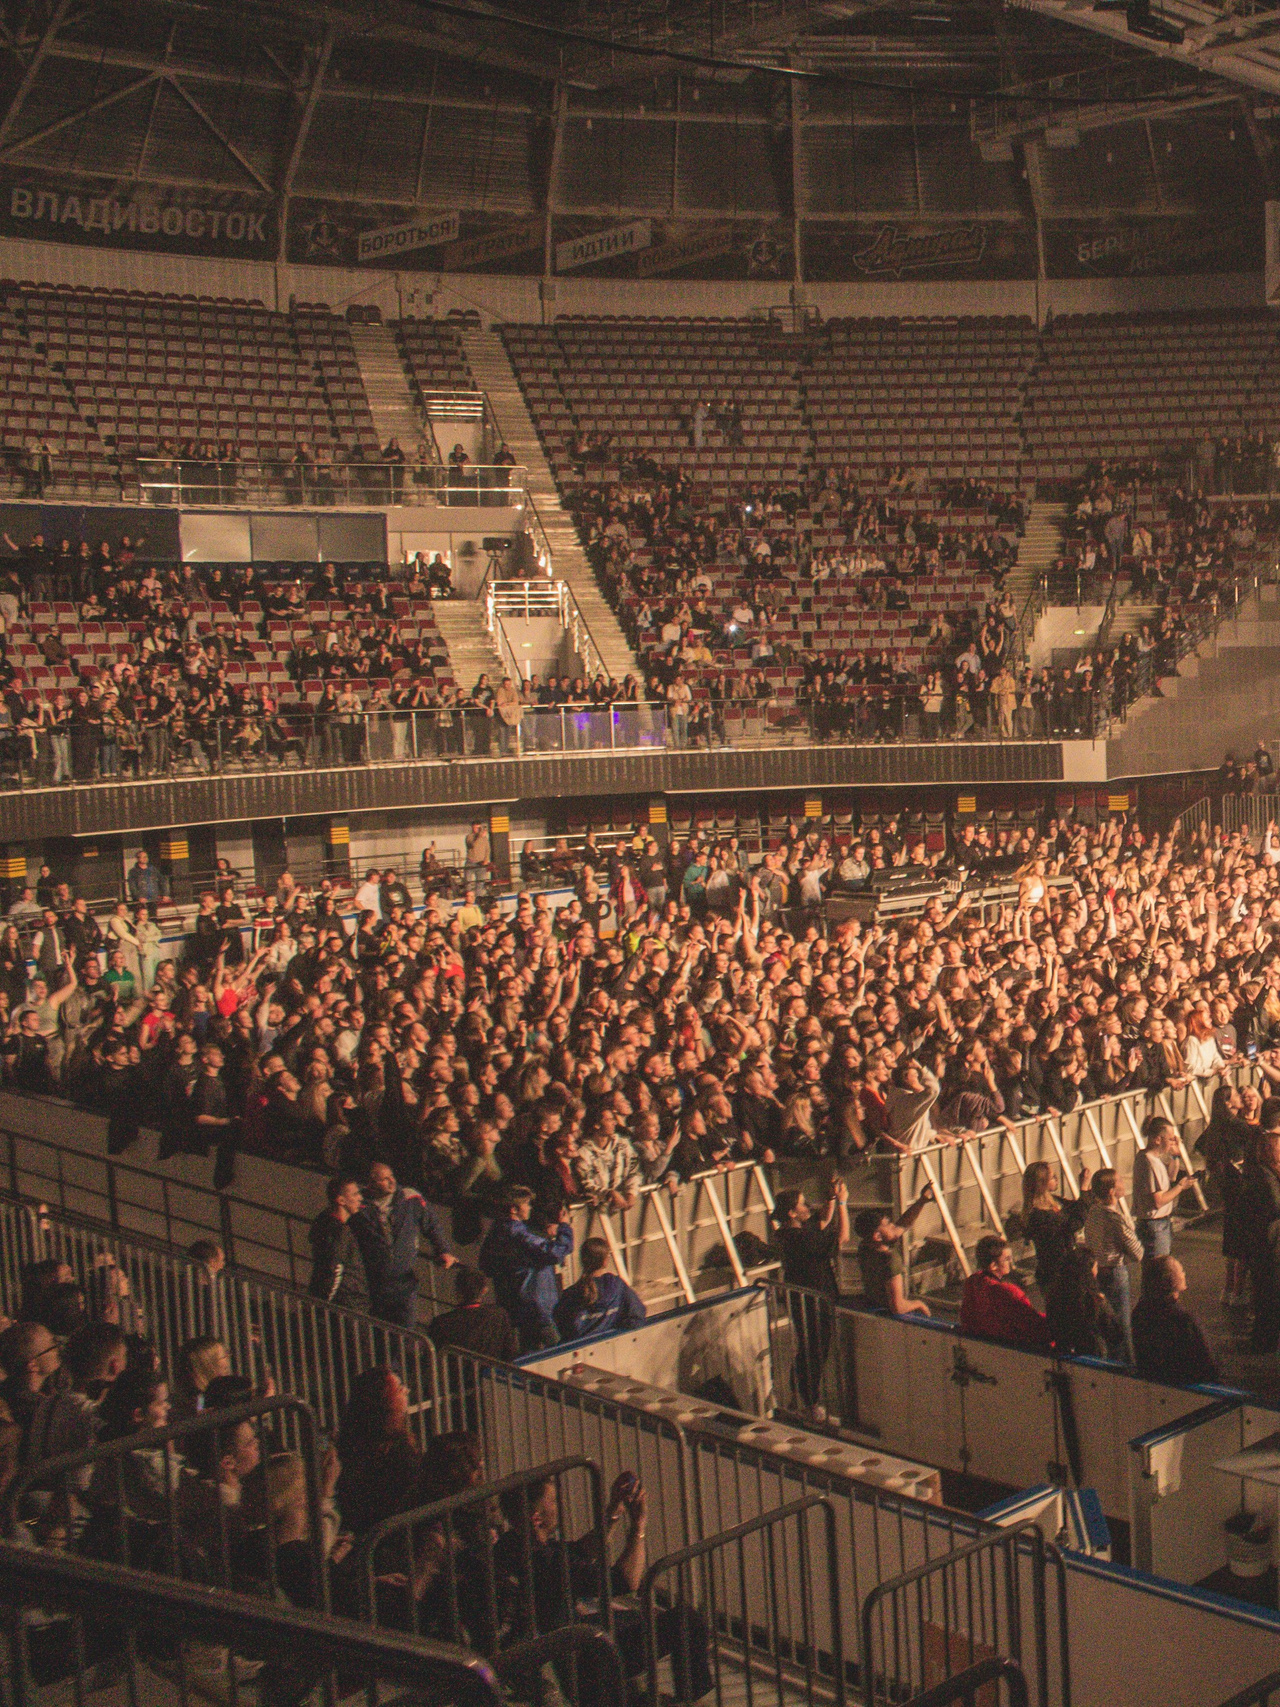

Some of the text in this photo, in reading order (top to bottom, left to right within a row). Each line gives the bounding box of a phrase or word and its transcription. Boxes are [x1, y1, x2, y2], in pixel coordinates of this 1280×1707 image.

[10, 188, 267, 242] ВЛАДИВОСТОК
[361, 217, 459, 254] БОРОТЬСЯ!
[572, 233, 619, 260] ИДТИ
